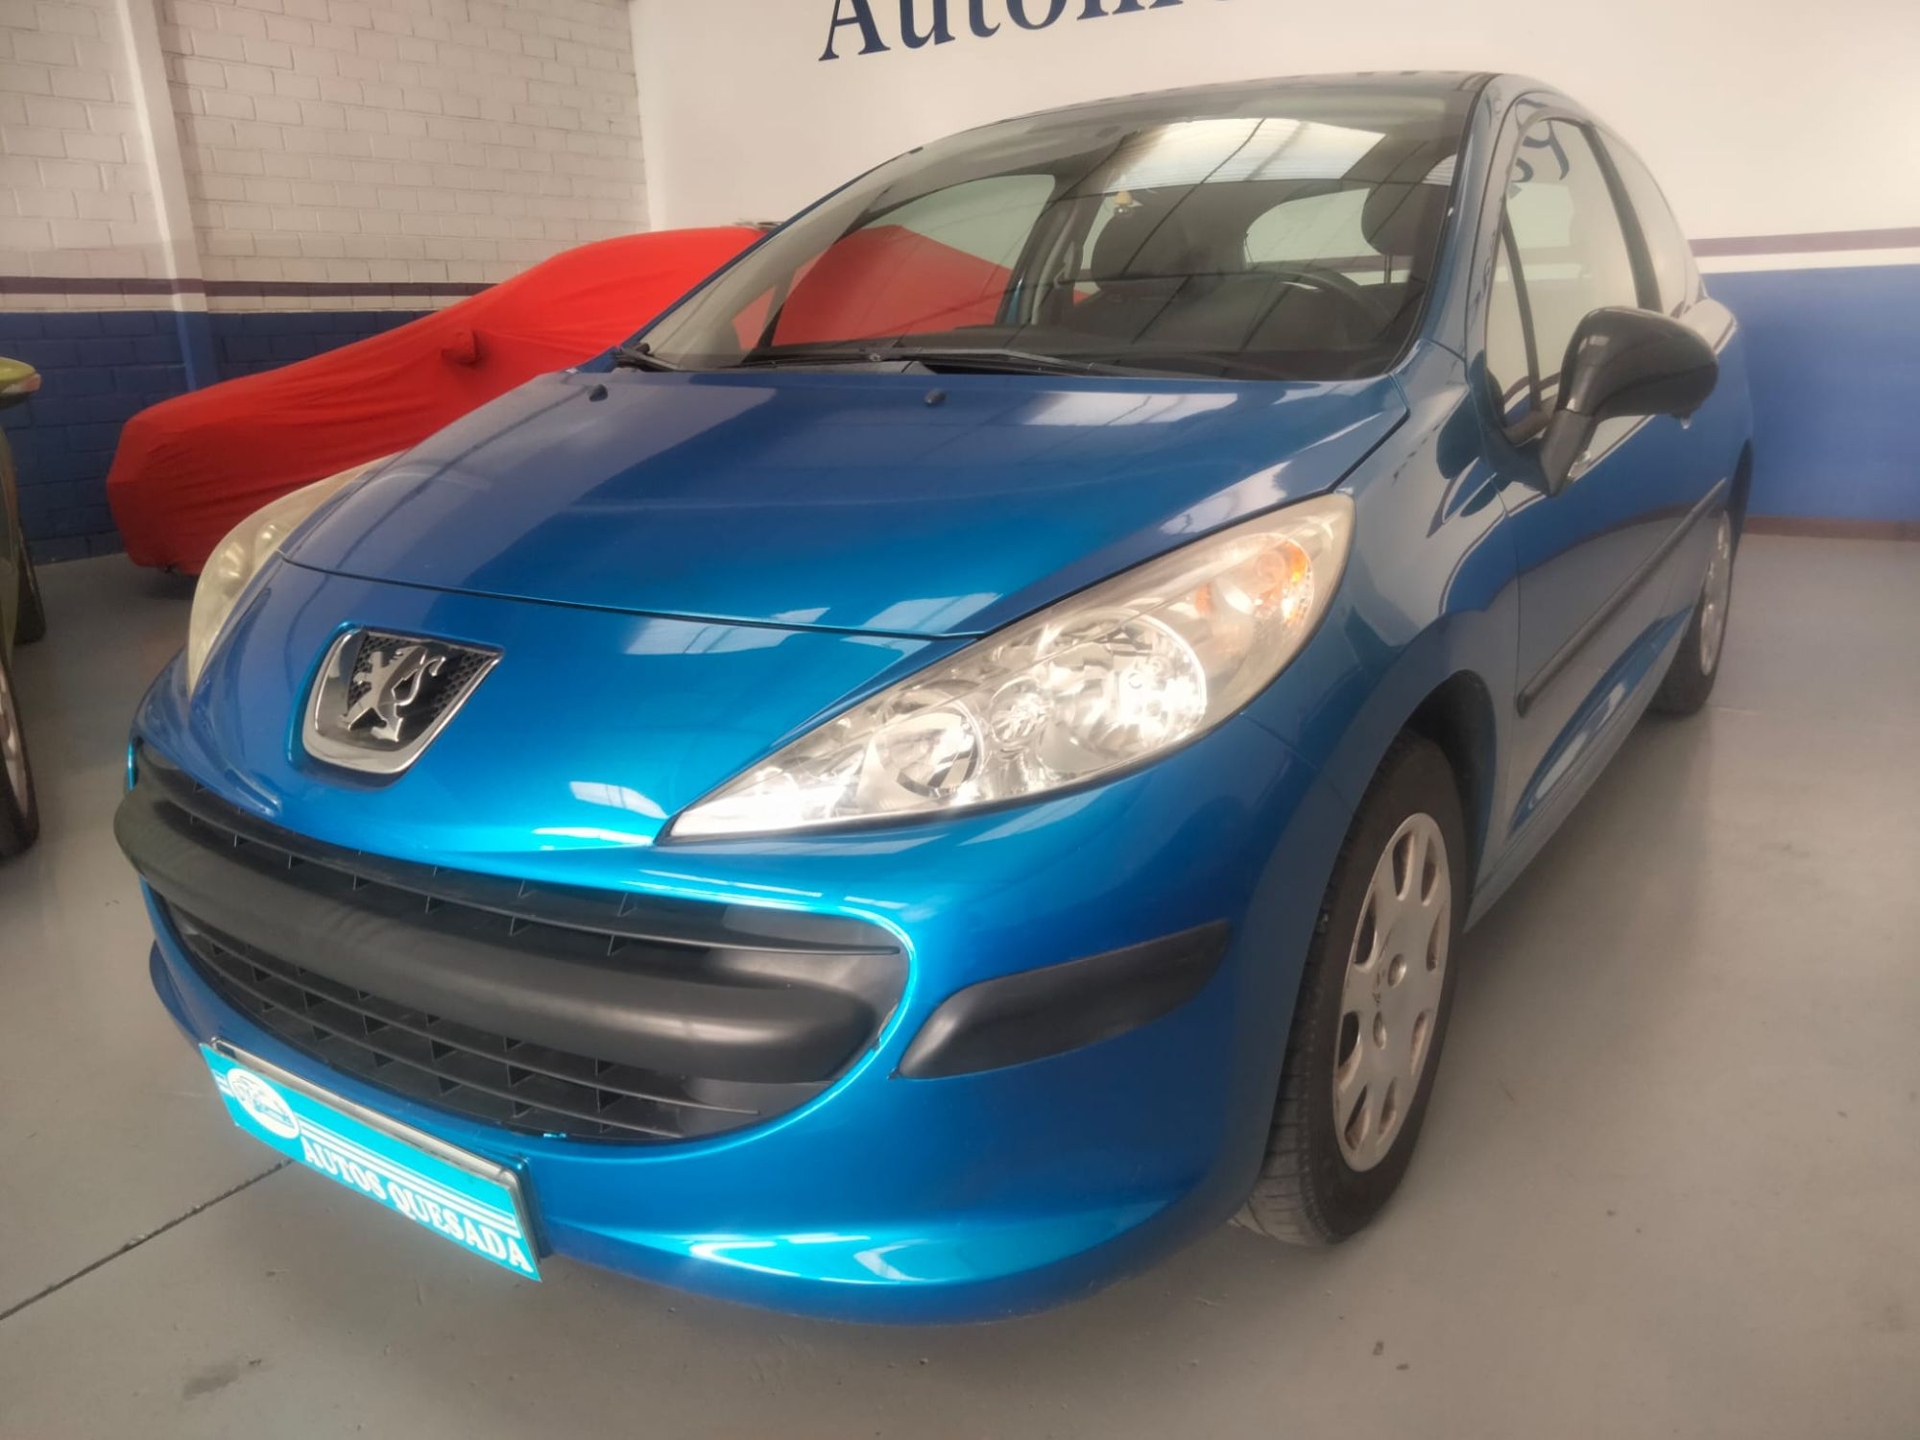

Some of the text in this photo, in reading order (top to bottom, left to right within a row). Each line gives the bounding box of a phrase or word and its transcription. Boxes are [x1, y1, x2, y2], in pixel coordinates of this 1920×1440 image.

[818, 0, 1184, 61] Auto
[301, 1137, 534, 1273] AUTOS QUESADA
